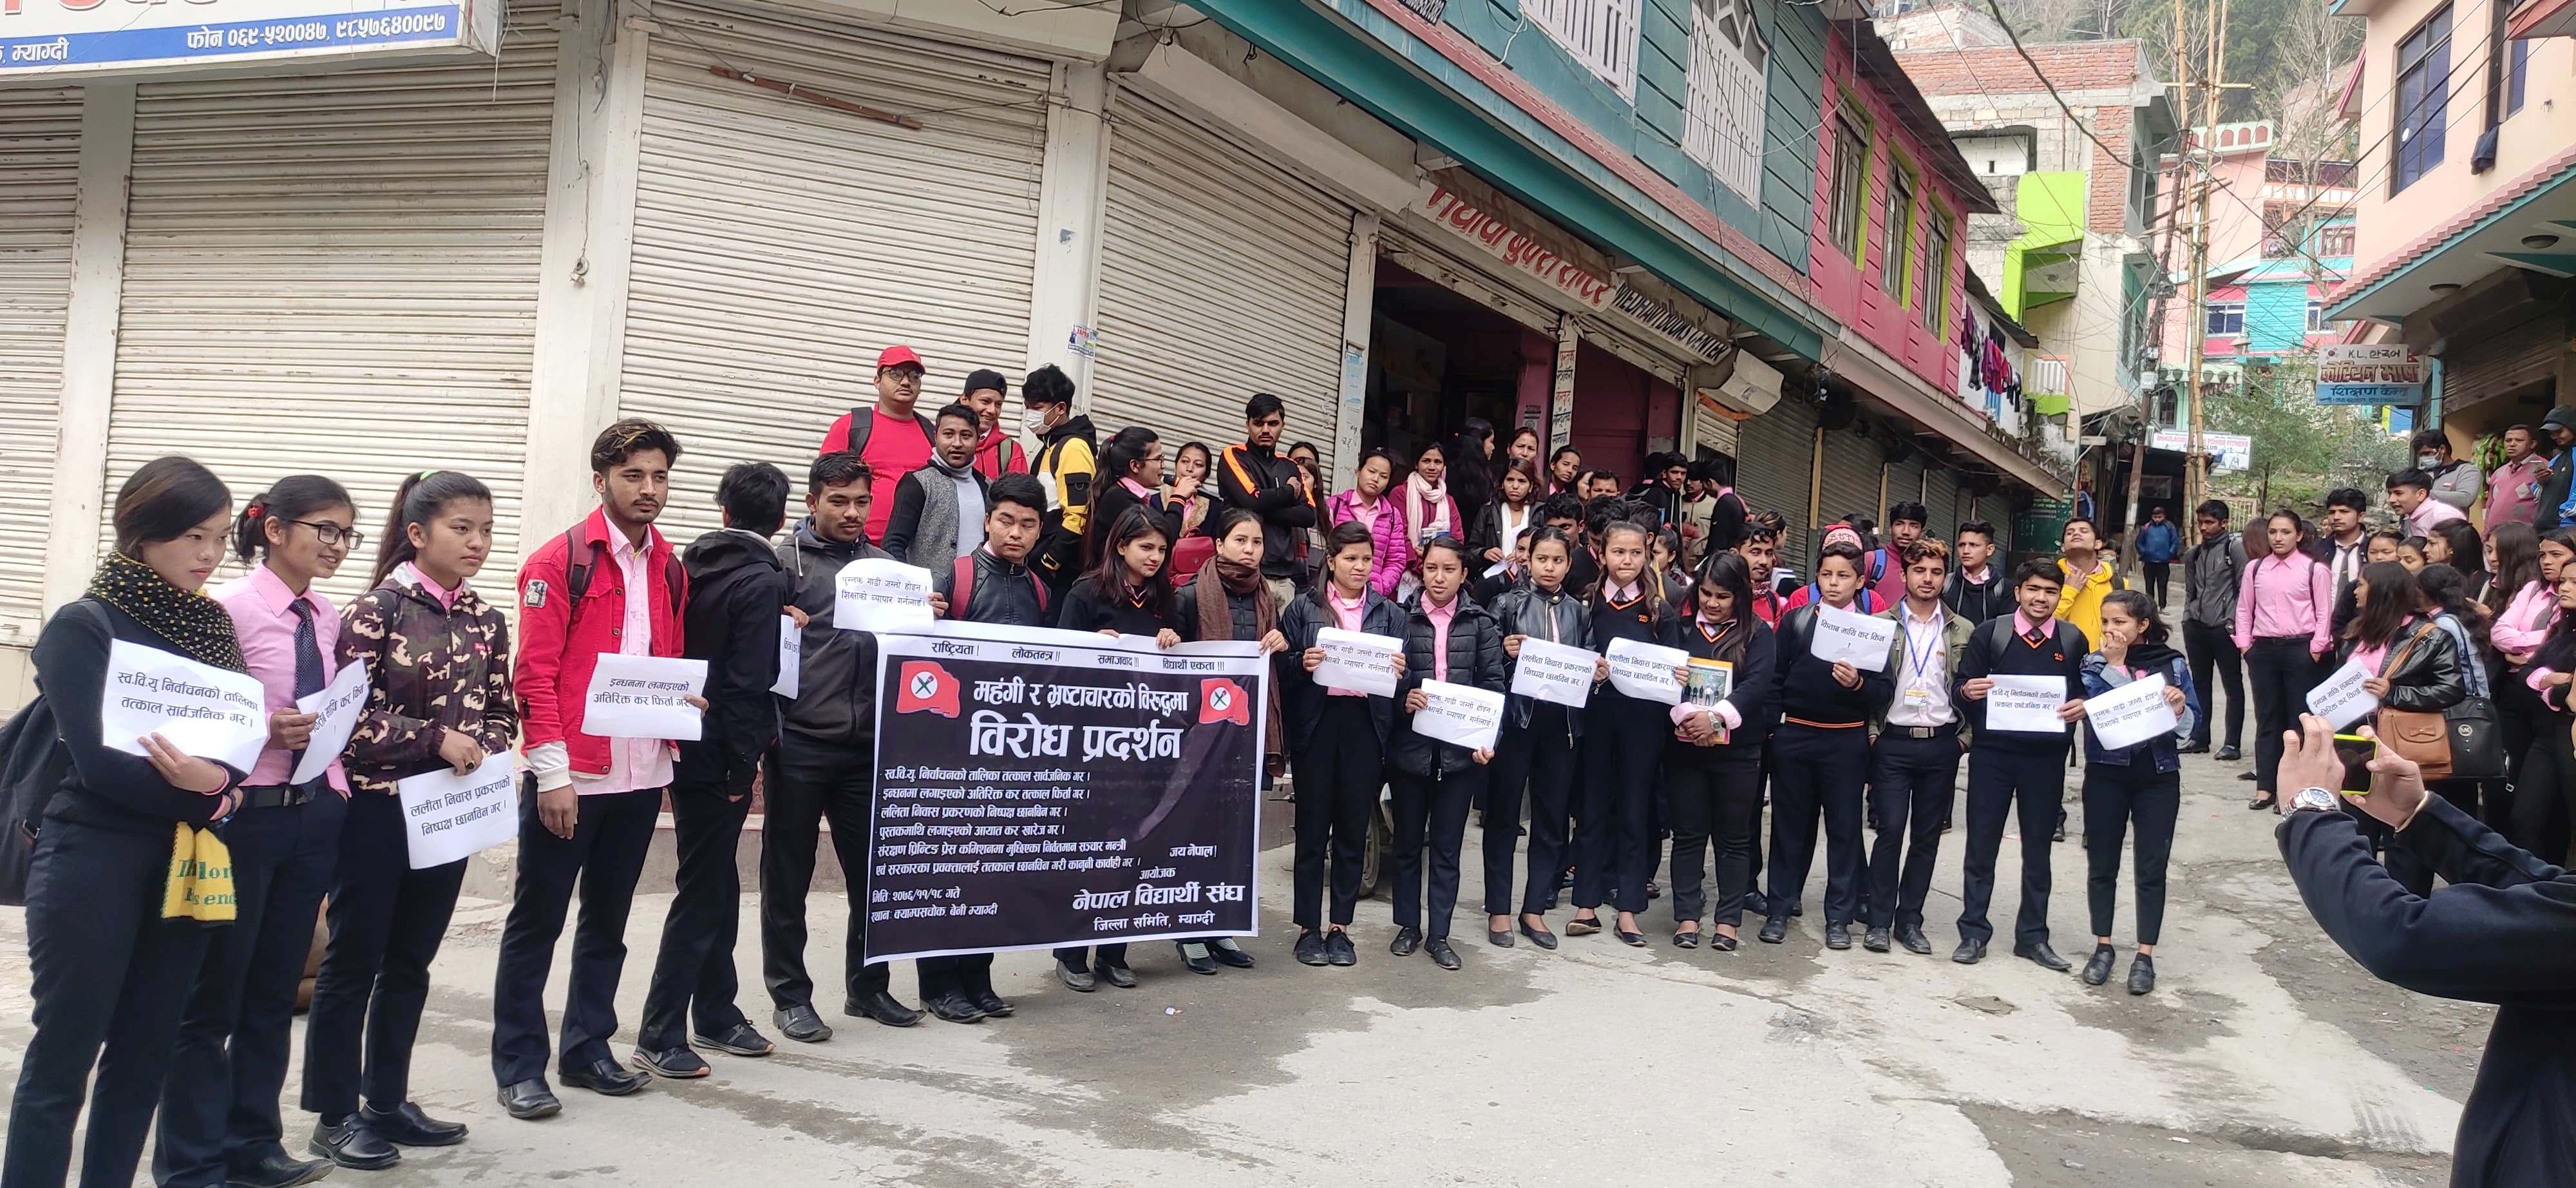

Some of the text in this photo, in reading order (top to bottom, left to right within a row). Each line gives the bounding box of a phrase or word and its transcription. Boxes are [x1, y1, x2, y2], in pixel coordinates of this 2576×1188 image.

[12, 37, 70, 62] म्याग्दी
[187, 26, 223, 49] फोन
[336, 13, 446, 39] ९८५७६४००९७
[1190, 662, 1215, 671] एकता
[162, 678, 220, 699] निर्वाचनको
[225, 691, 258, 711] तालिका
[648, 681, 690, 692] लगाइएको
[973, 676, 1026, 705] महंगी
[1029, 684, 1043, 706] र
[1047, 683, 1135, 709] भ्रष्टाचारको
[593, 691, 632, 704] अतिरिक्त
[634, 696, 649, 705] कर
[652, 695, 674, 706] फिर्ता
[121, 696, 247, 725] तत्काल सार्वजनिक गर
[969, 709, 1184, 763] विरोध प्रदर्शन
[919, 766, 966, 781] निर्वाचनको
[969, 767, 1000, 781] तालिका
[1002, 771, 1031, 781] तत्काल
[1033, 769, 1072, 781] सार्वजनिक
[1073, 772, 1085, 781] गर
[410, 775, 510, 817] ललीता निवास प्रकरणको
[883, 787, 918, 800] इन्धनमा
[920, 786, 964, 800] लगाइएको
[967, 786, 1004, 800] अतिरिक्त
[1005, 790, 1019, 800] कर
[1052, 786, 1072, 800] फिर्ता
[1073, 790, 1085, 800] गर
[422, 818, 453, 836] निष्पक्ष
[491, 801, 502, 814] गर
[881, 805, 909, 818] ललिता
[911, 803, 940, 818] निवास
[942, 805, 985, 818] प्रकरणको
[1050, 807, 1062, 817] गर
[880, 823, 1059, 840] पुस्तकमाथि लगाइएको आयात कर खारेज गर
[878, 844, 907, 857] संरक्षण
[941, 841, 957, 856] प्रेस
[1170, 847, 1187, 858] जय
[887, 863, 930, 876] सरकारका
[1051, 858, 1066, 870] गरी
[1122, 858, 1134, 867] गर
[1139, 866, 1176, 880] आयोजक
[945, 886, 961, 899] गते
[1072, 881, 1245, 910] नेपाल विद्यार्थी संघ
[950, 904, 967, 916] बेनी
[969, 903, 998, 915] म्याग्दी
[1094, 917, 1129, 932] जिल्ला
[1178, 910, 1215, 926] म्याग्दी
